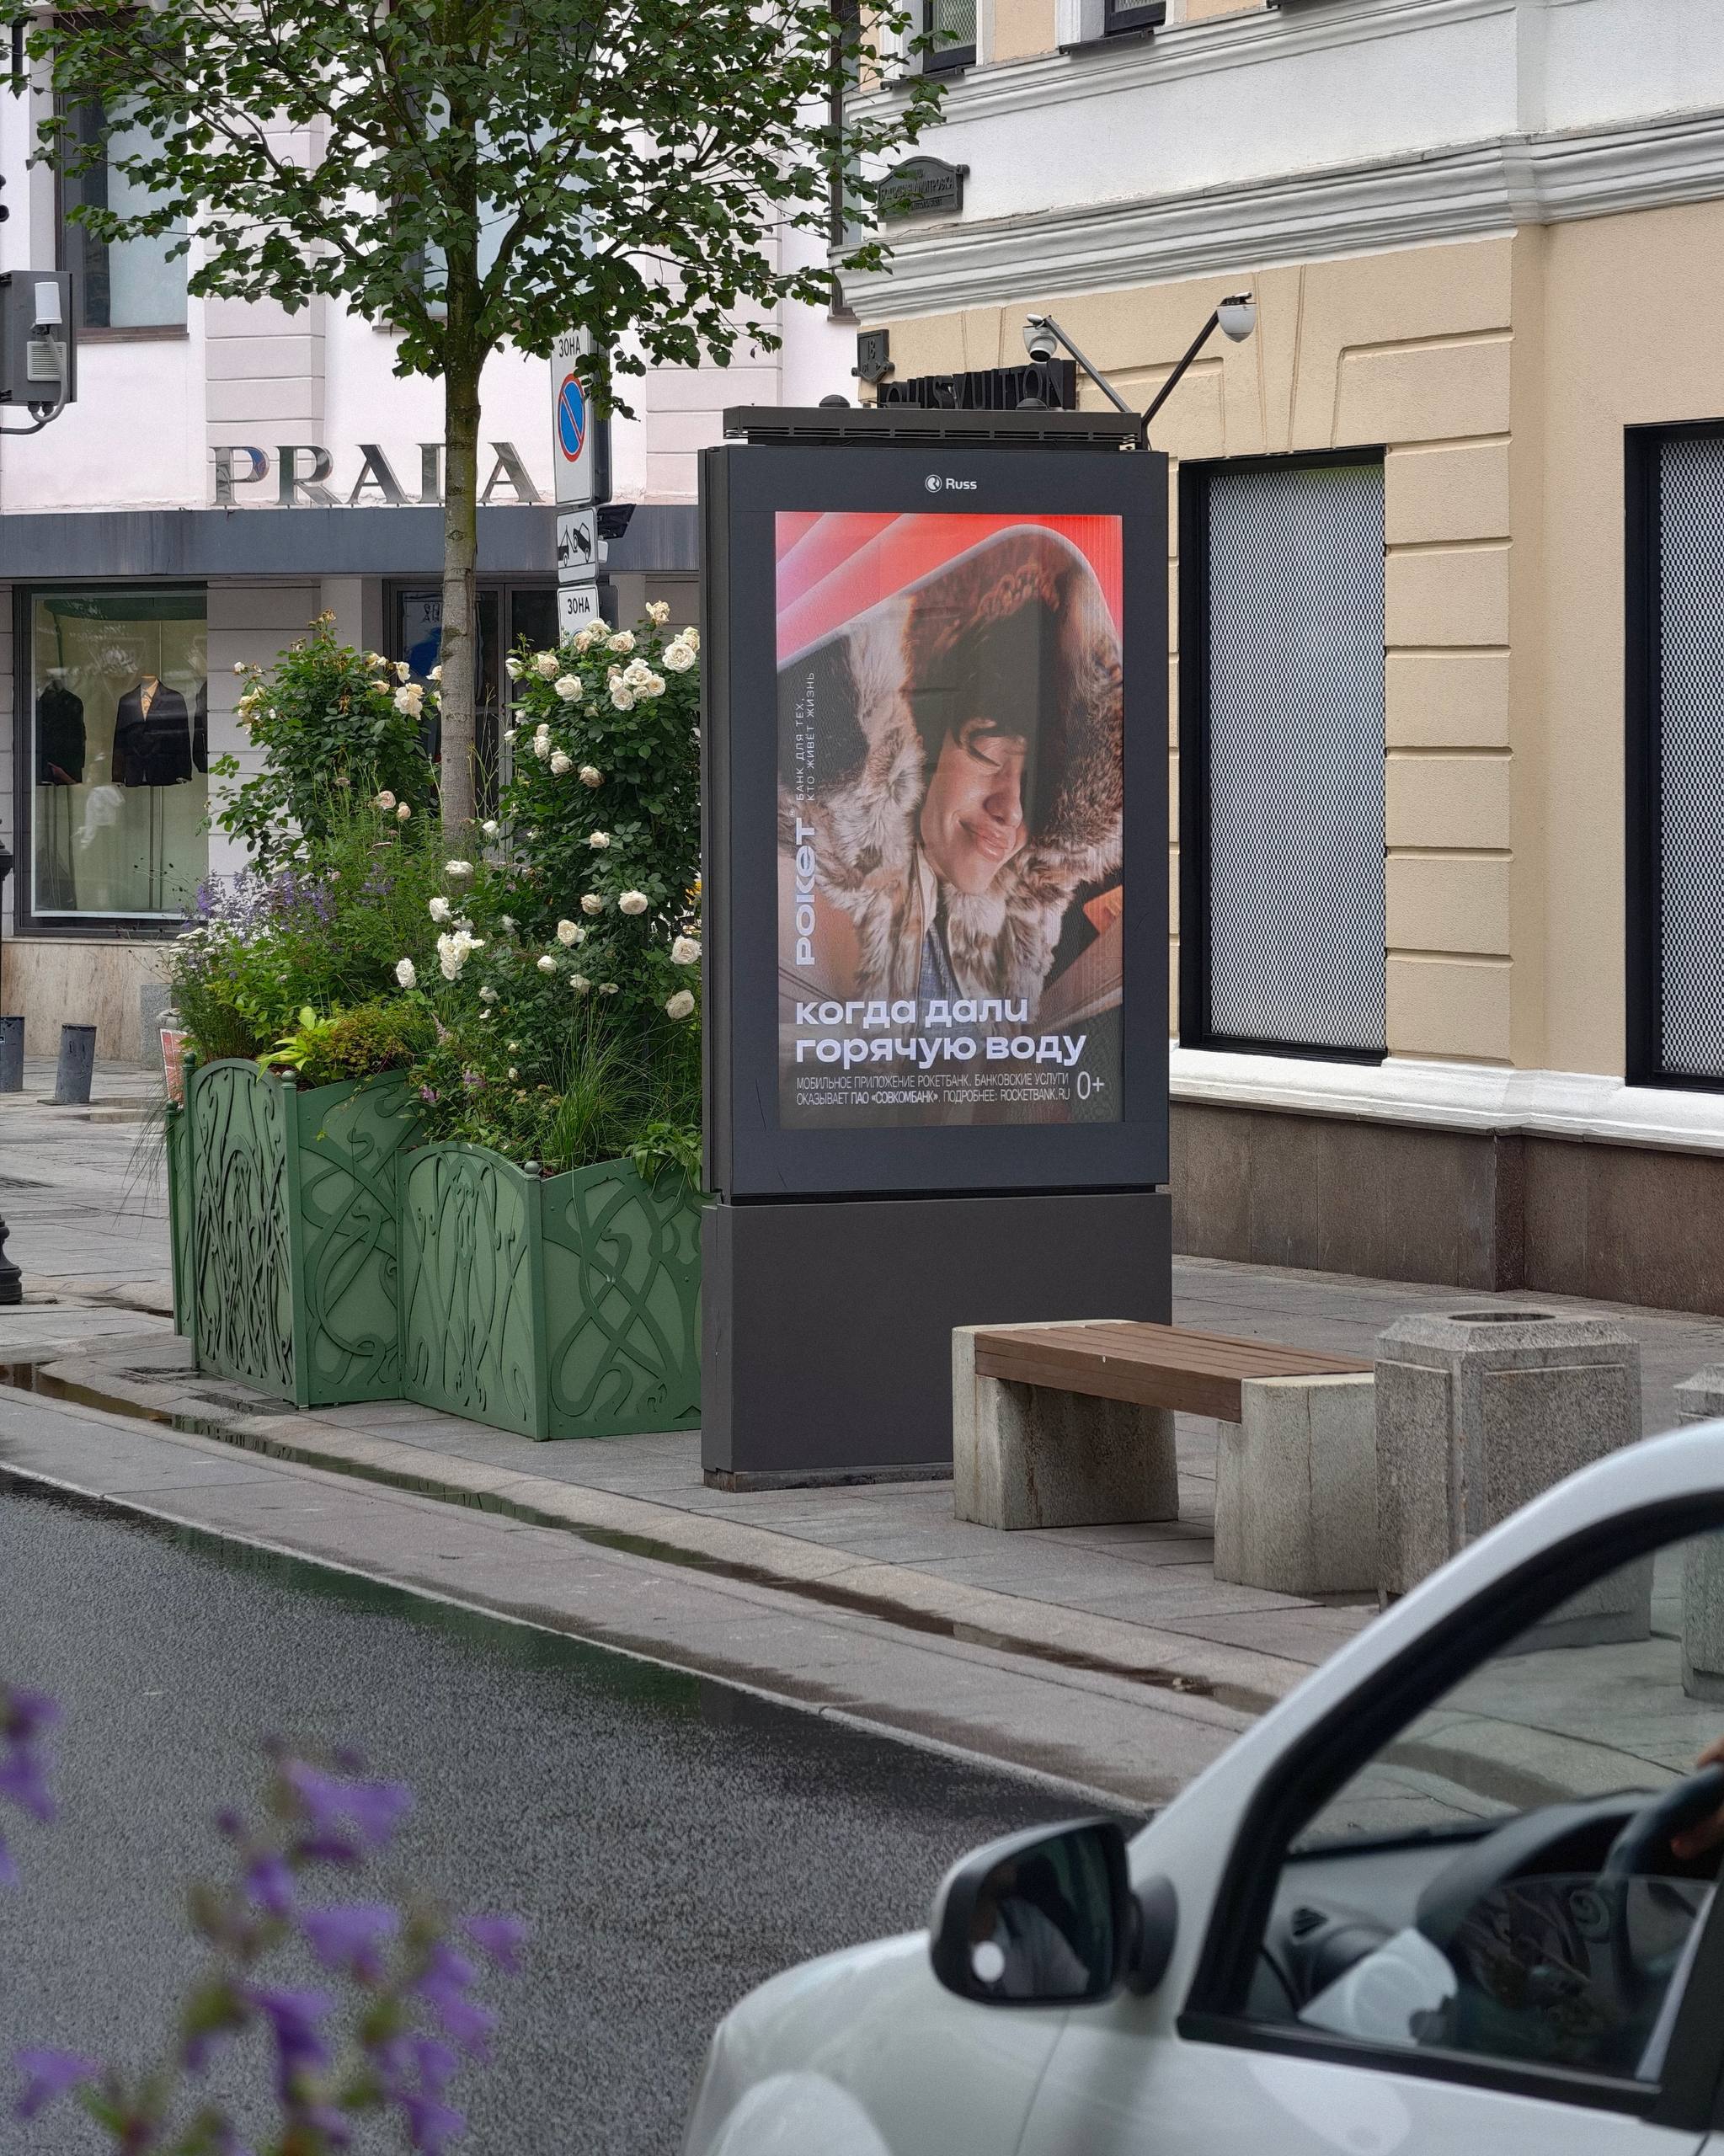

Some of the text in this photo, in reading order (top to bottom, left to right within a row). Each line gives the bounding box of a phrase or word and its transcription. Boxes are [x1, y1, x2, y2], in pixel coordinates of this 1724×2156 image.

[559, 336, 581, 358] ЗОНА
[945, 478, 978, 490] Russ
[567, 596, 590, 615] ЗОНА
[806, 672, 815, 718] ЖИЗНЬ
[796, 698, 805, 801] БАНК ДЛЯ ТЕХ,
[806, 776, 815, 801] КТО
[796, 999, 1027, 1029] когда дали
[796, 1035, 1086, 1070] горячую воду
[796, 1072, 1069, 1090] МОБИЛЬНОЕ ПРИЛОЖЕНИЕ РОКЕТБАНК. БАНКОВСКИЕ УСЛУГИ
[1076, 1070, 1105, 1100] 0+
[796, 1087, 1070, 1106] ОКАЗЫВАЕТ ПАО «СОВКОМБАНК». ПОДРОБНЕЕ: ROCKETBANK.RU
